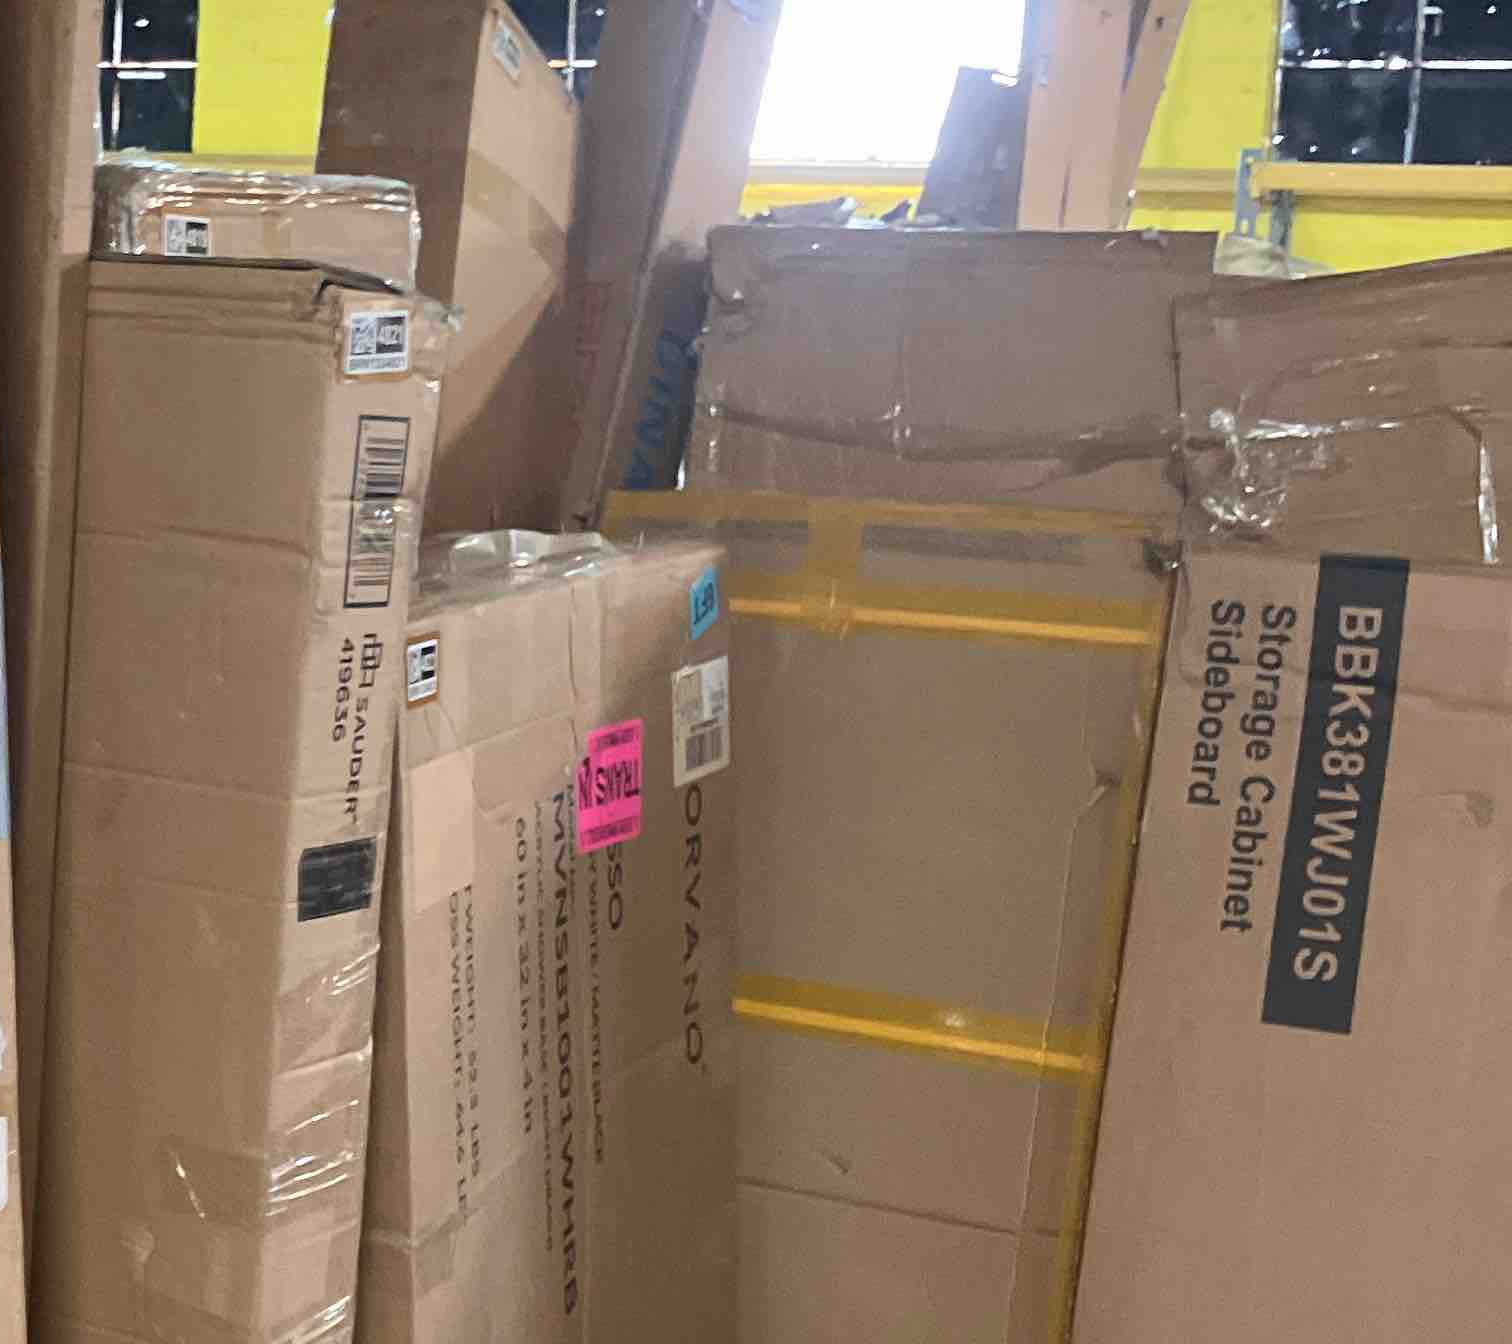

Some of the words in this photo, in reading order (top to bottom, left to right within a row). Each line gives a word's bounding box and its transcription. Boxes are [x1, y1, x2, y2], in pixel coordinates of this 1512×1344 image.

[331, 637, 356, 744] 419636
[345, 697, 369, 816] SAUDER
[1185, 598, 1247, 808] Sideboard
[1243, 604, 1297, 762] Storage
[514, 815, 528, 864] 60
[1219, 775, 1276, 934] Cabinet
[1292, 604, 1384, 984] BBK381WJ01S
[682, 784, 703, 1065] ORVANO
